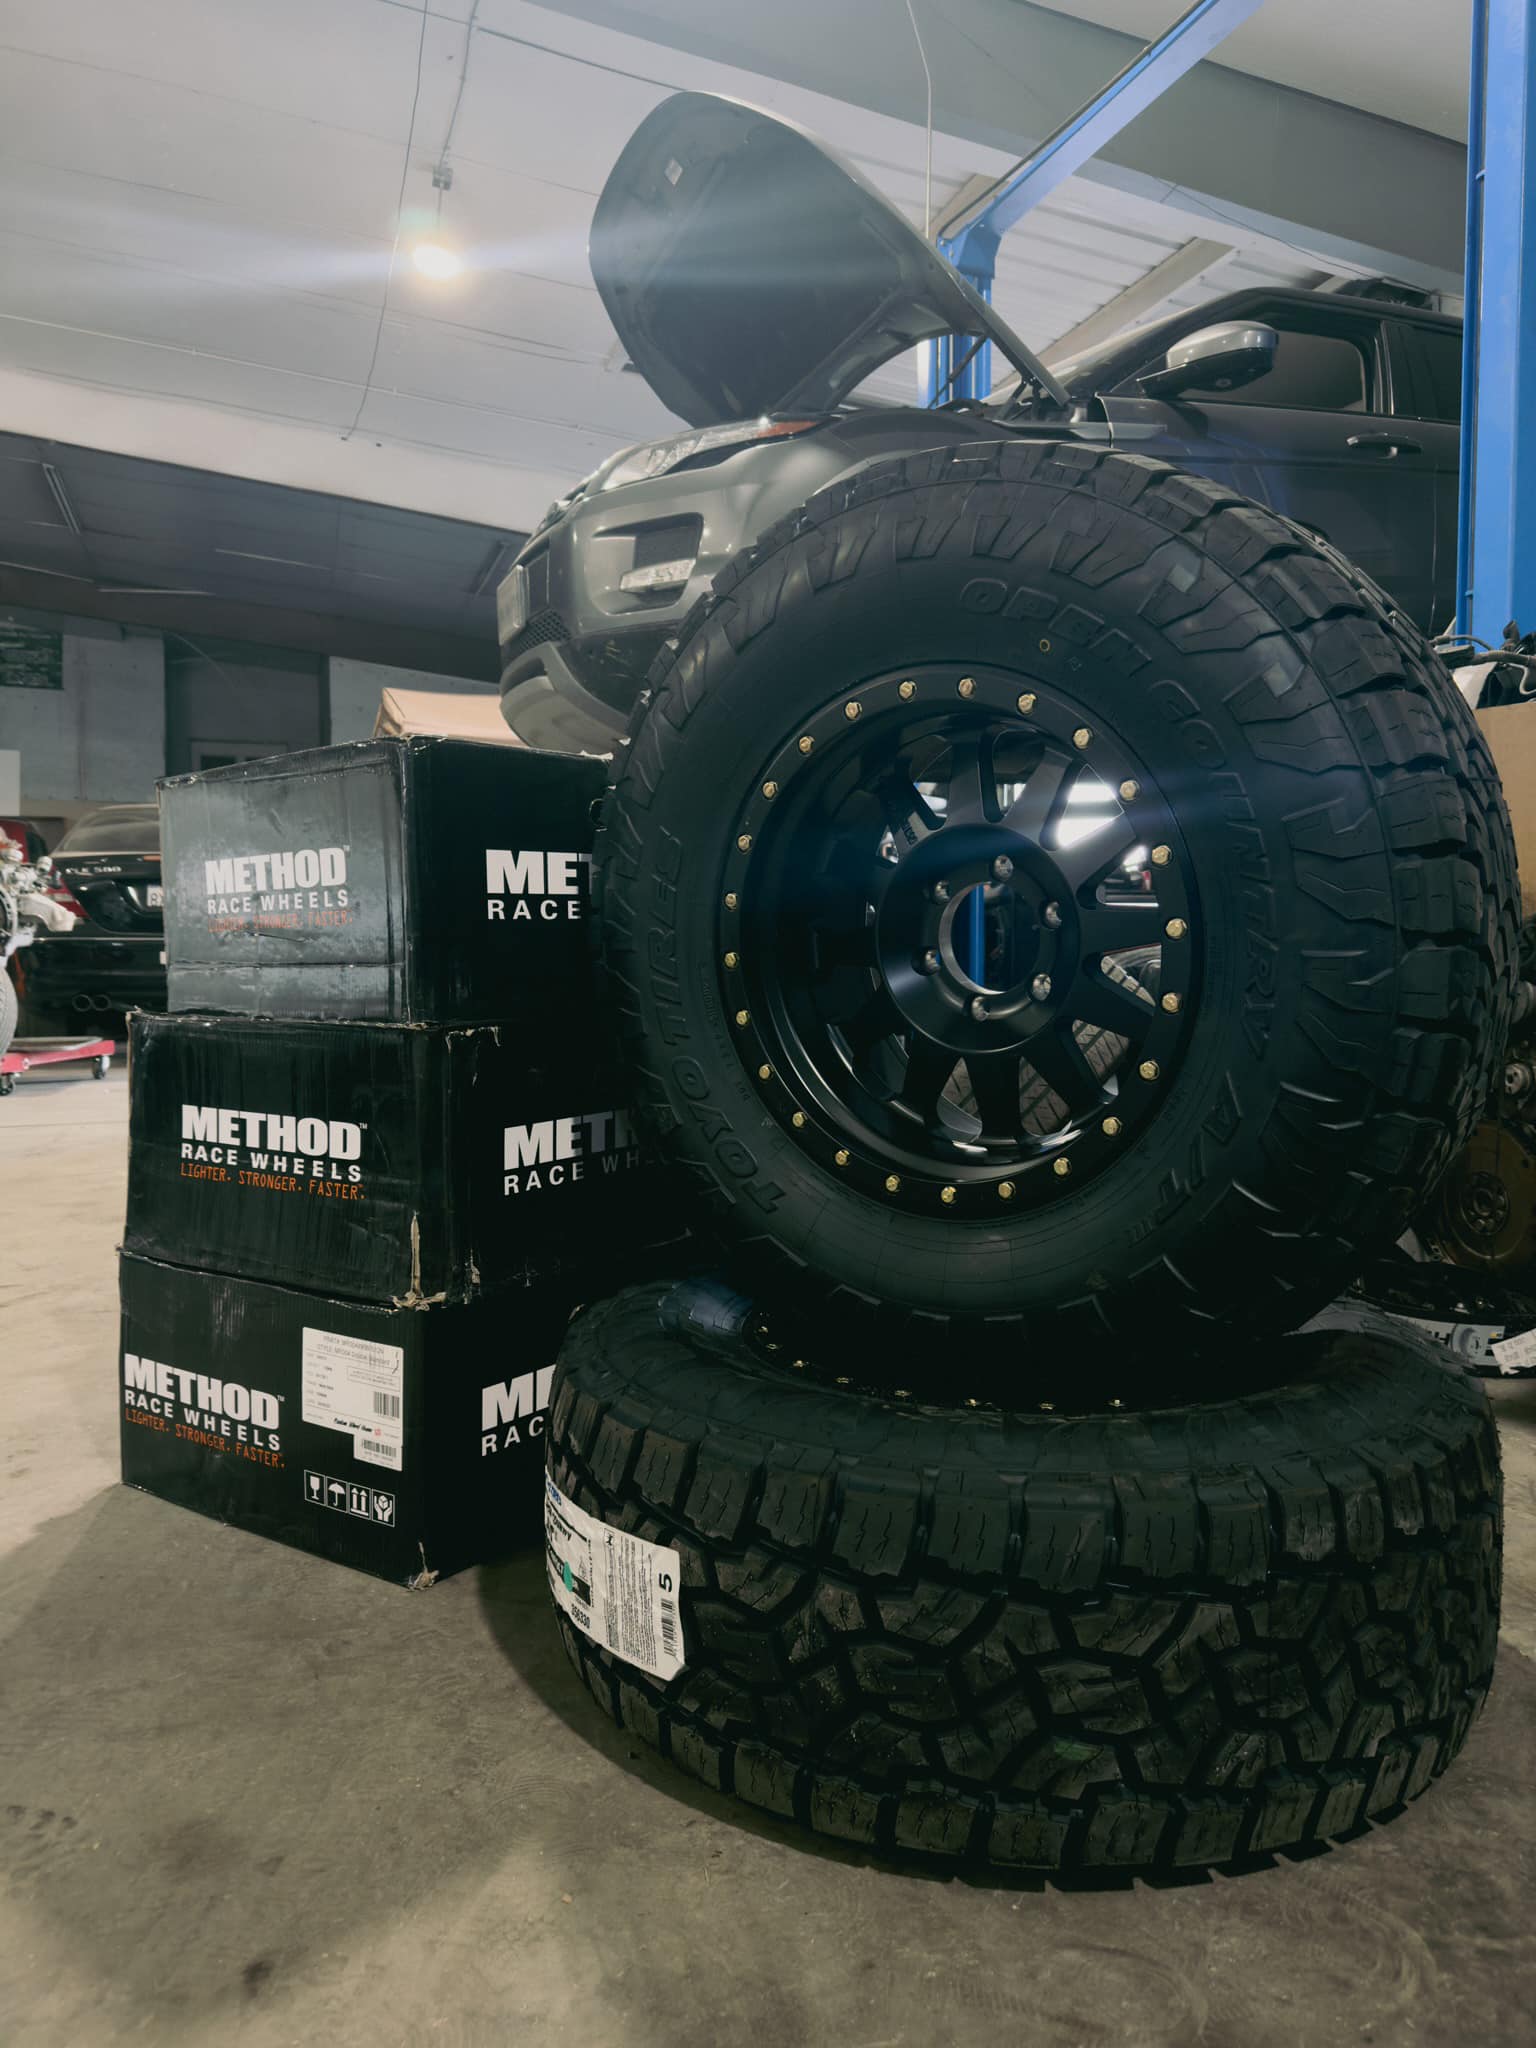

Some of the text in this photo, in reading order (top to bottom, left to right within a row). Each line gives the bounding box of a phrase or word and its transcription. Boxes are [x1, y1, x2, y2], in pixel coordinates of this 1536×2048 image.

[205, 847, 347, 896] METHOD
[207, 889, 349, 915] RACE WHEELS
[487, 899, 582, 920] RACE
[182, 1103, 362, 1161] METHOD
[670, 1055, 787, 1214] TOYO
[180, 1163, 232, 1182] LIGHTER.
[238, 1170, 303, 1192] STRONGER.
[181, 1143, 362, 1183] RACE WHEELS
[504, 1161, 585, 1197] RACE
[124, 1353, 280, 1431] METHOD
[125, 1390, 281, 1452] RACE WHEELS
[658, 1572, 673, 1593] 5
